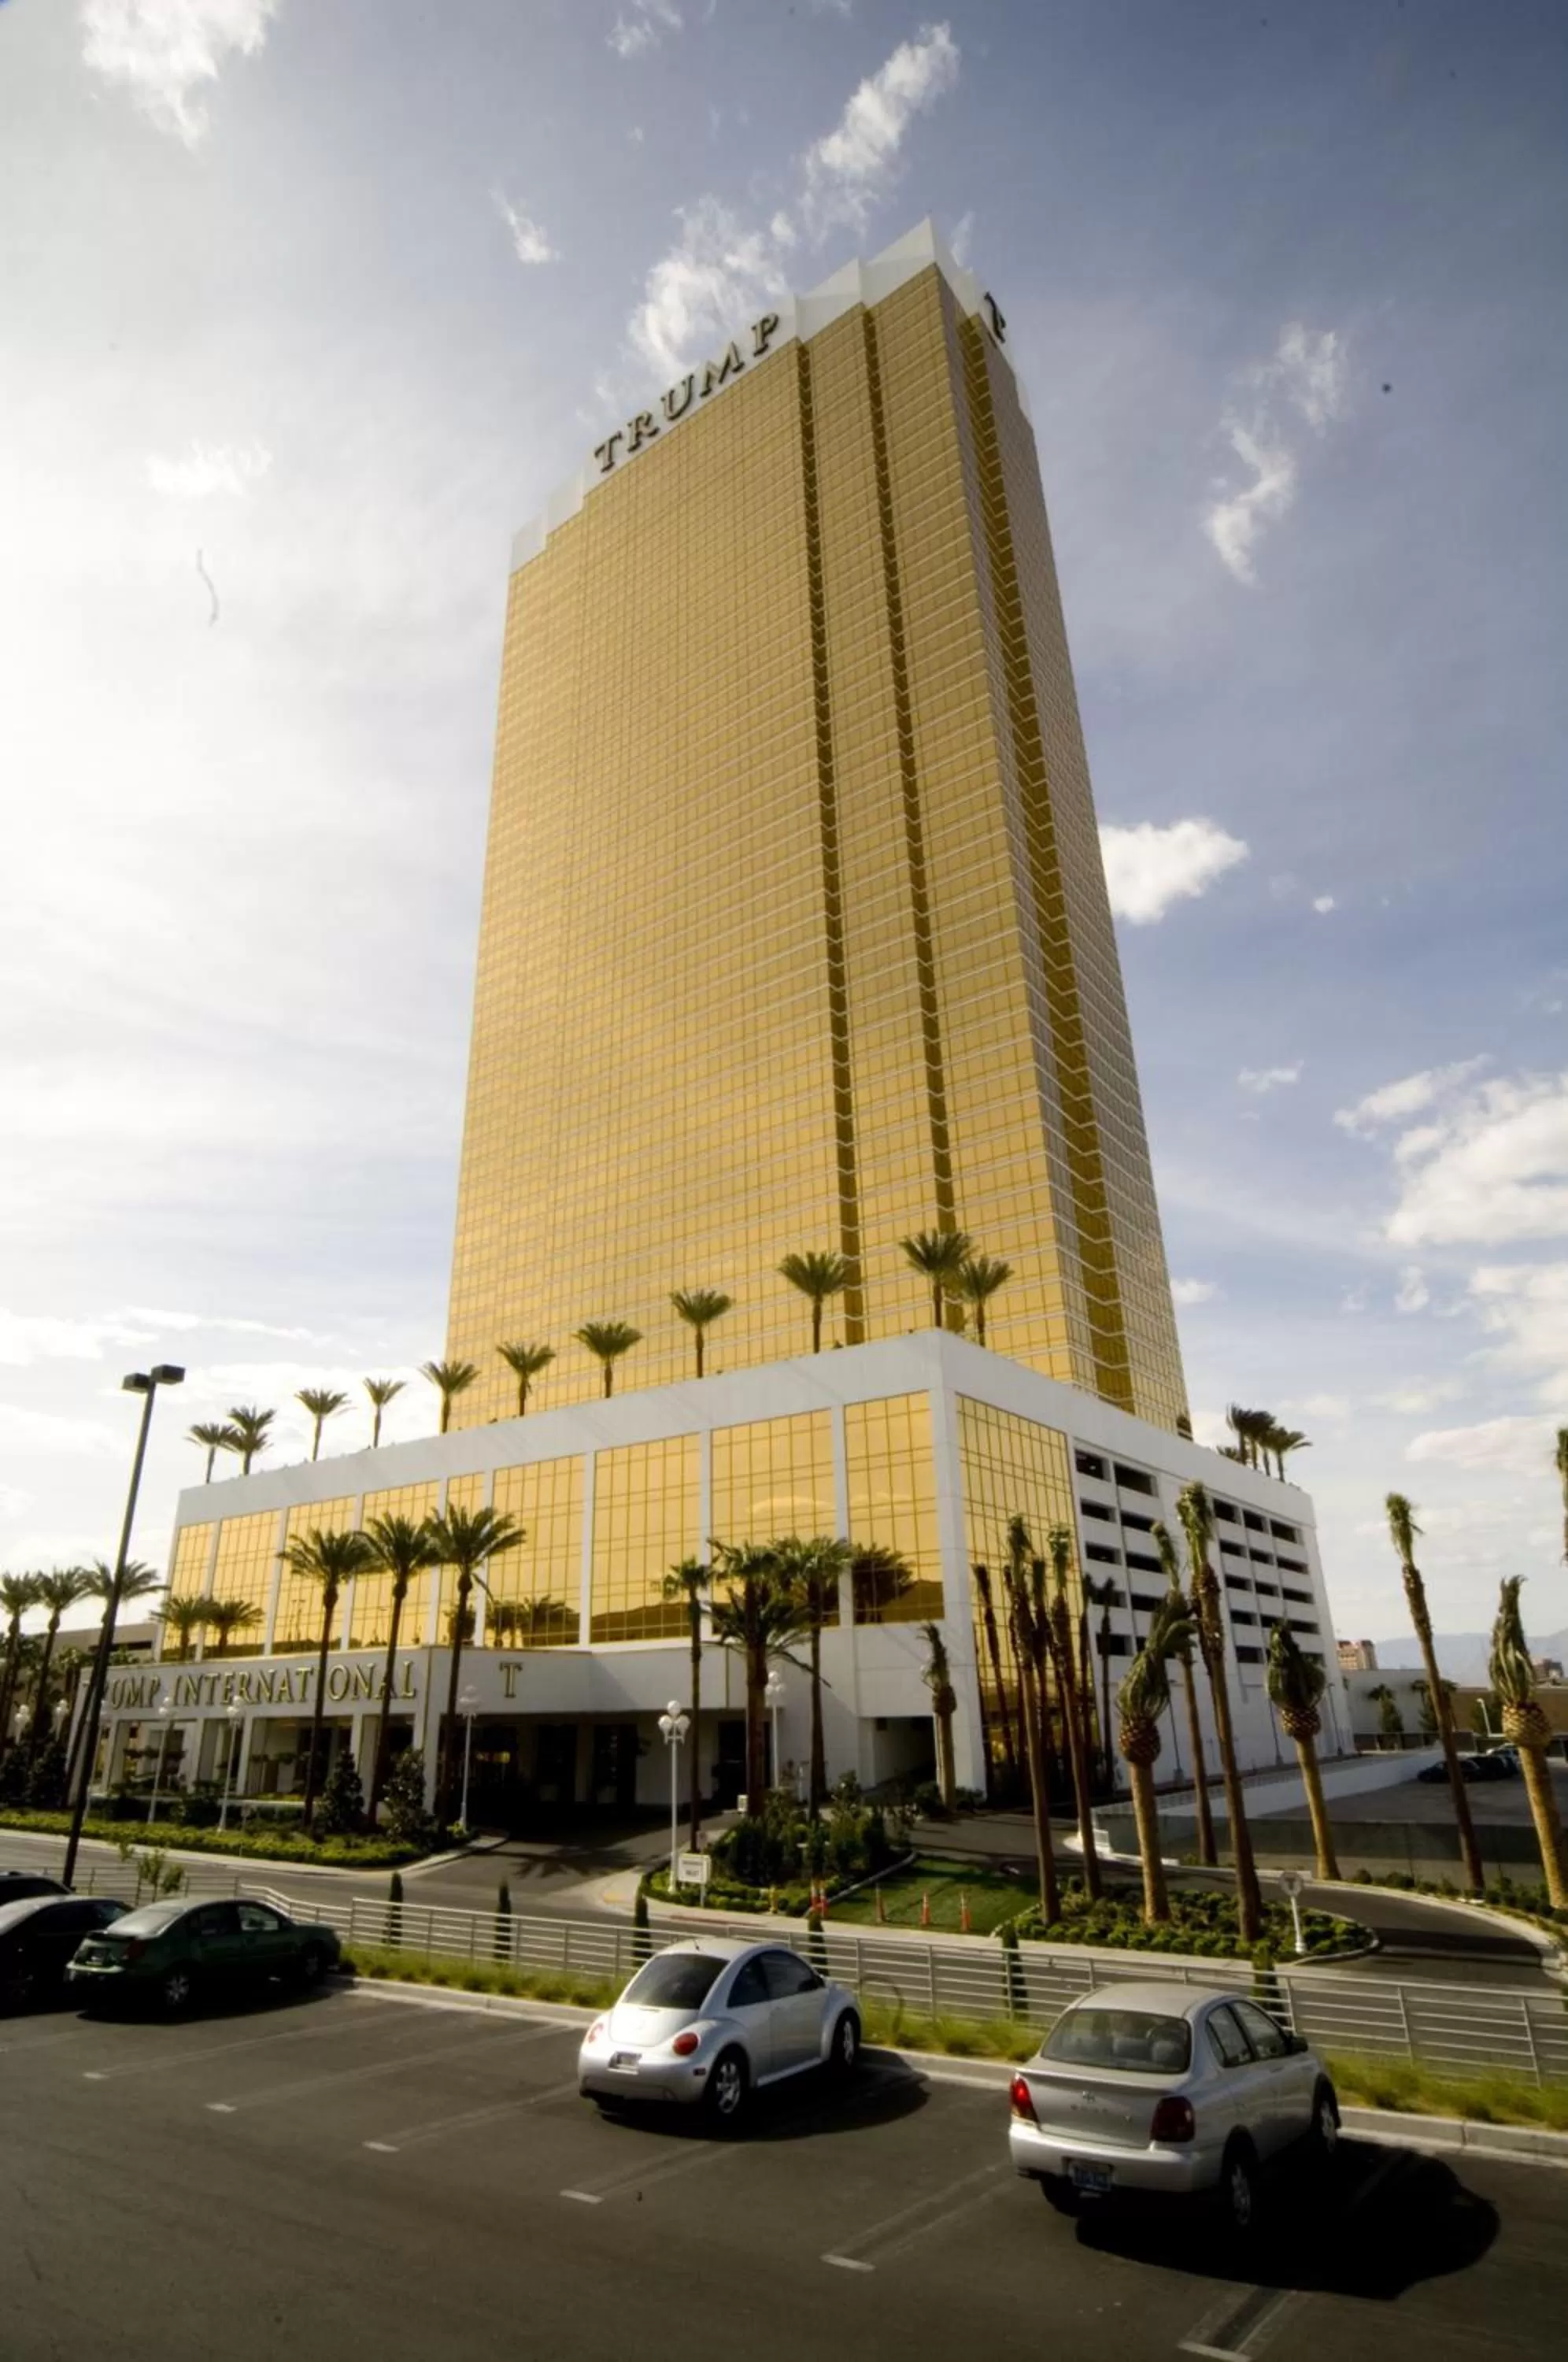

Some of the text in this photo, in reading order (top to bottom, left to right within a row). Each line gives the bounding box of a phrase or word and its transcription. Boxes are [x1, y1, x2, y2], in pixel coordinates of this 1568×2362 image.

[594, 313, 779, 473] TRUMP
[82, 1660, 417, 1710] UMP INTERNATONAL
[499, 1660, 524, 1698] T
